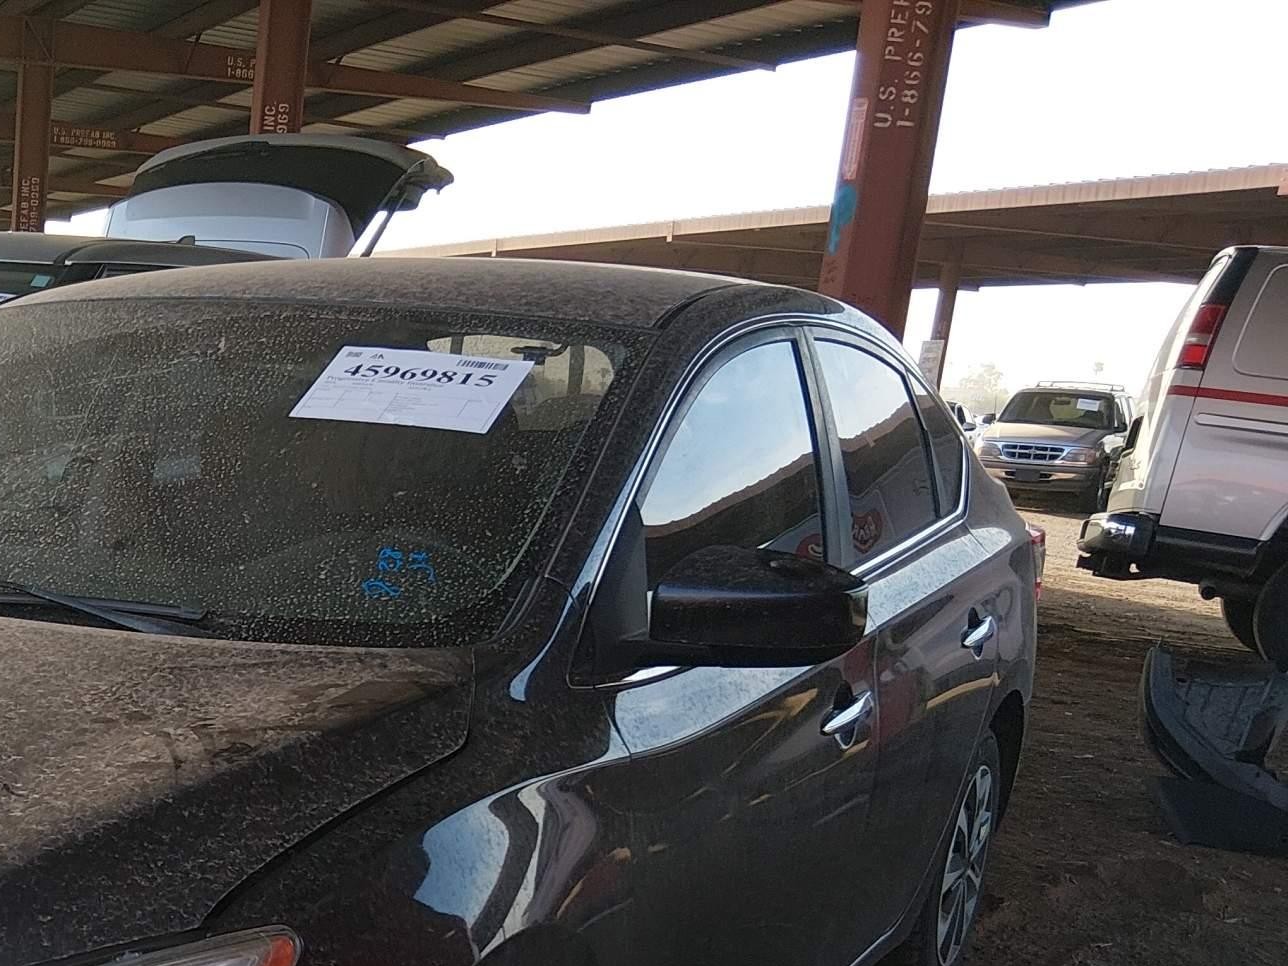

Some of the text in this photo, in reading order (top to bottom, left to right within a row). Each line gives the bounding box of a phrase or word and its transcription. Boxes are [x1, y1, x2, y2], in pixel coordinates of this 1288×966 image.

[227, 55, 245, 68] U.S.
[227, 67, 254, 80] 1-866
[896, 1, 933, 127] 1-866-79
[263, 101, 277, 131] INC.
[276, 103, 289, 134] 969
[873, 79, 898, 128] U.S.
[343, 363, 497, 388] 45969815
